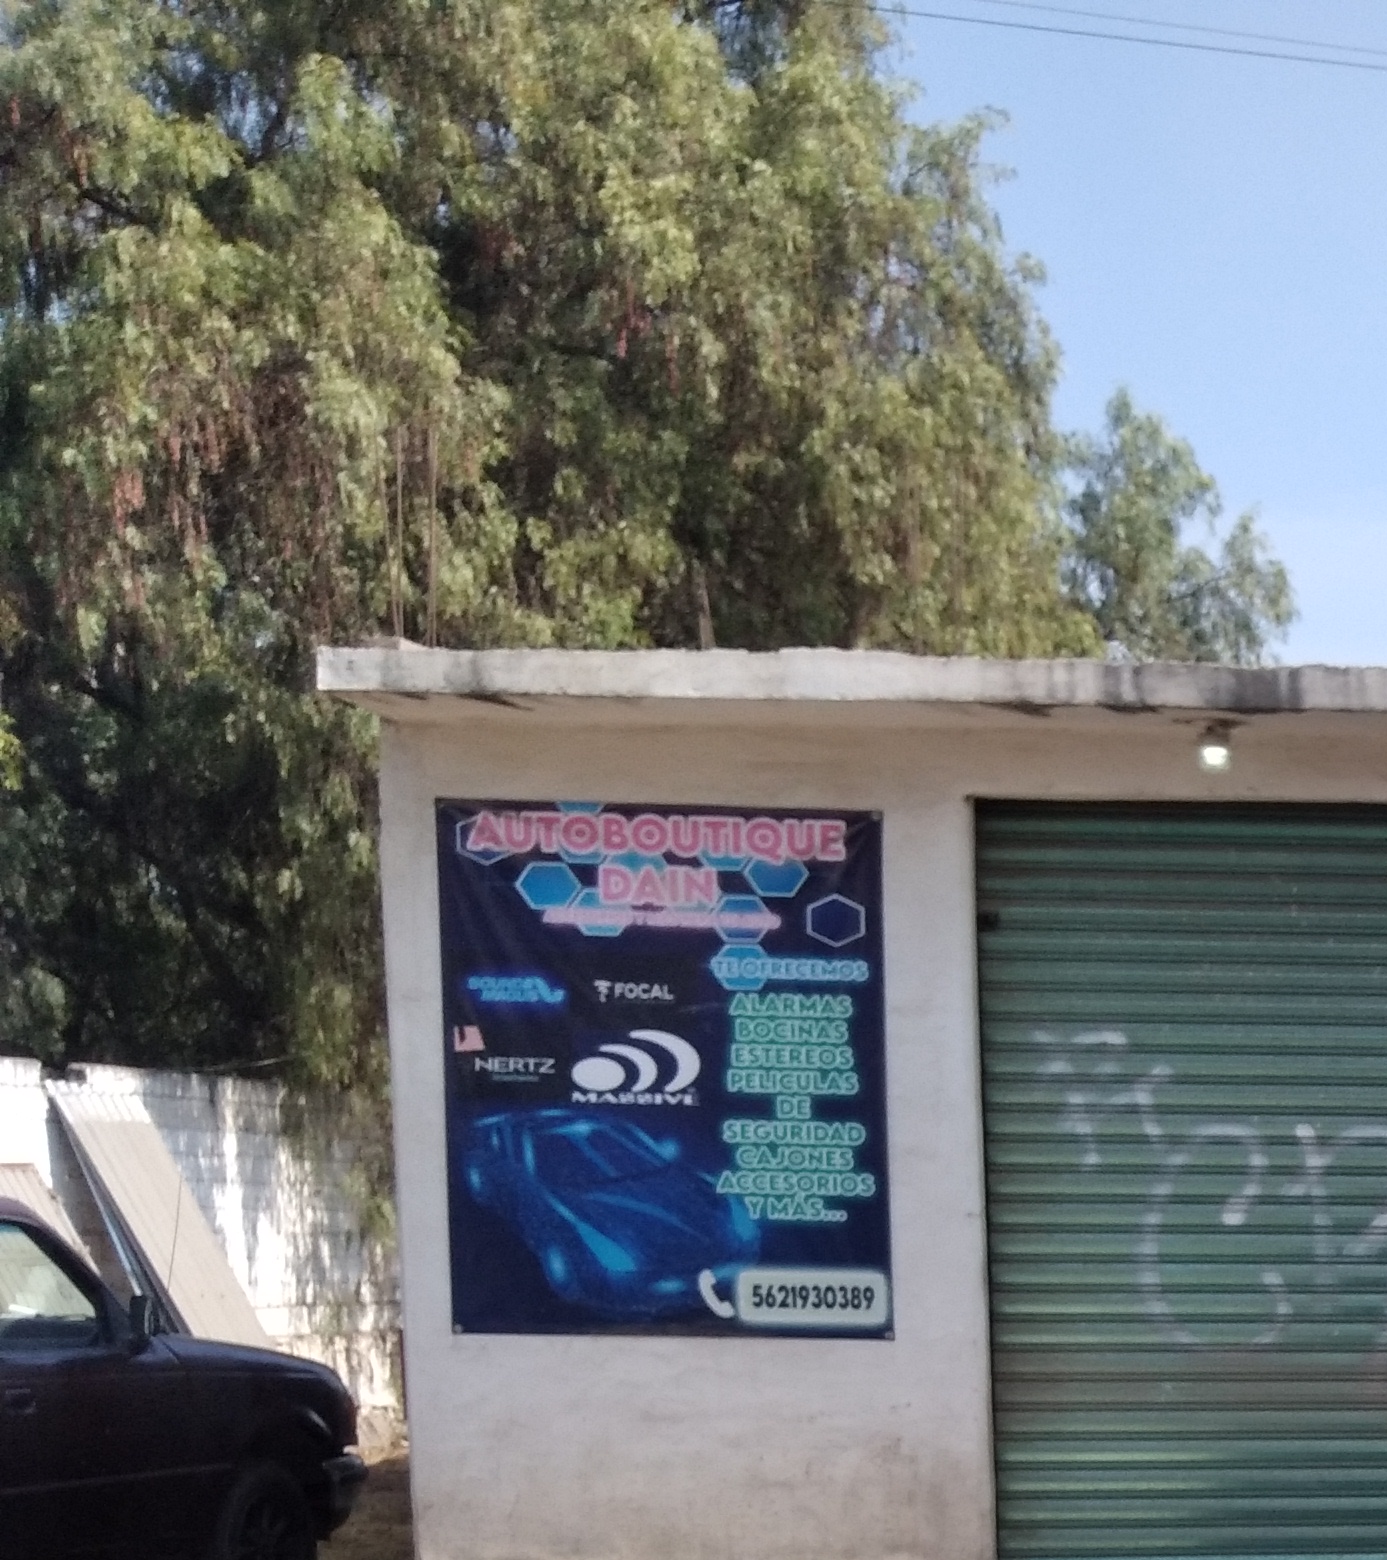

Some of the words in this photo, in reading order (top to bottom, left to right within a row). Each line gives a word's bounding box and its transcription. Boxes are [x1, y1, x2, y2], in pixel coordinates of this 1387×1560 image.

[467, 812, 847, 864] AUTOBOUTIQUE
[600, 867, 719, 905] DAIN
[713, 958, 738, 979] TE
[741, 958, 868, 981] OFRECEMOS
[614, 983, 674, 1000] FOCAL
[730, 993, 852, 1017] ALARMAS
[736, 1018, 848, 1043] BOCINAS
[731, 1043, 854, 1069] ESTEREOS
[727, 1069, 859, 1094] PELICULAS
[777, 1096, 811, 1118] DE
[723, 1120, 866, 1145] SEGURIDAD
[737, 1146, 854, 1170] CAJONES
[717, 1171, 876, 1196] ACCESORIOS
[745, 1197, 763, 1219] Y
[752, 1285, 875, 1309] 5621930389
